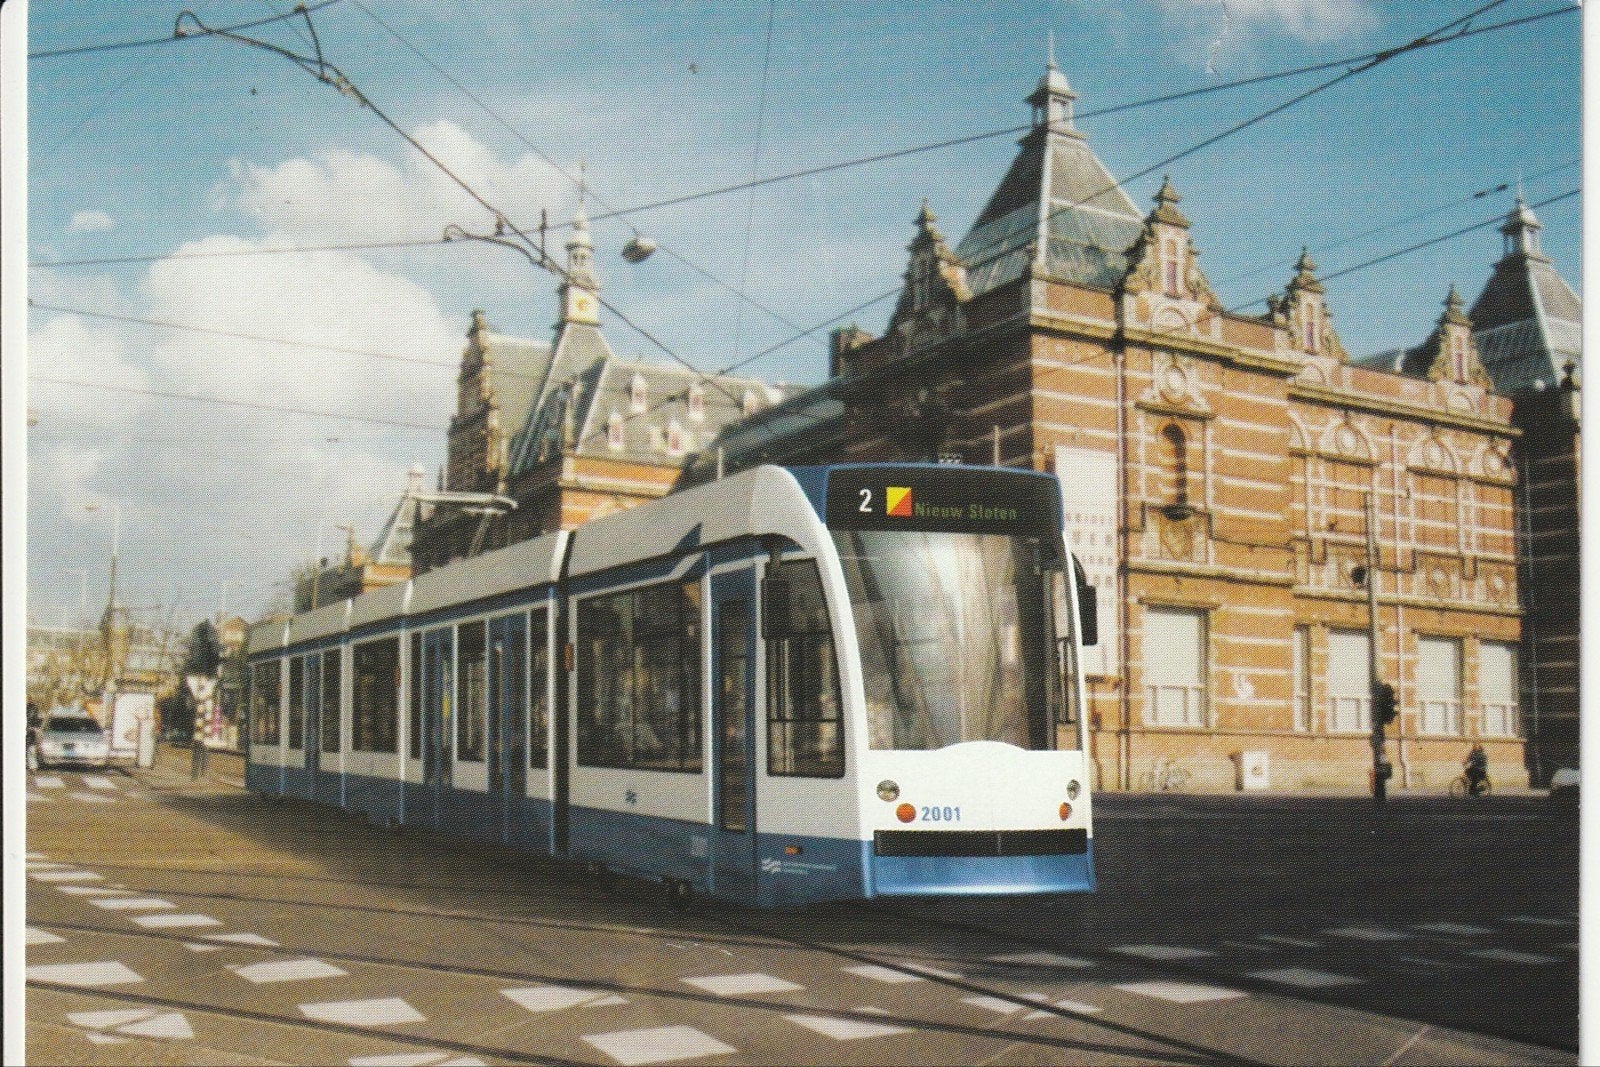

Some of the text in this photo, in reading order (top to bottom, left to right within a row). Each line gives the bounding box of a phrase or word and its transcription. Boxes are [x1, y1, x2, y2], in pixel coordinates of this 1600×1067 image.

[859, 489, 1018, 520] 2 Nieuw Sloten
[921, 806, 961, 821] 2001
